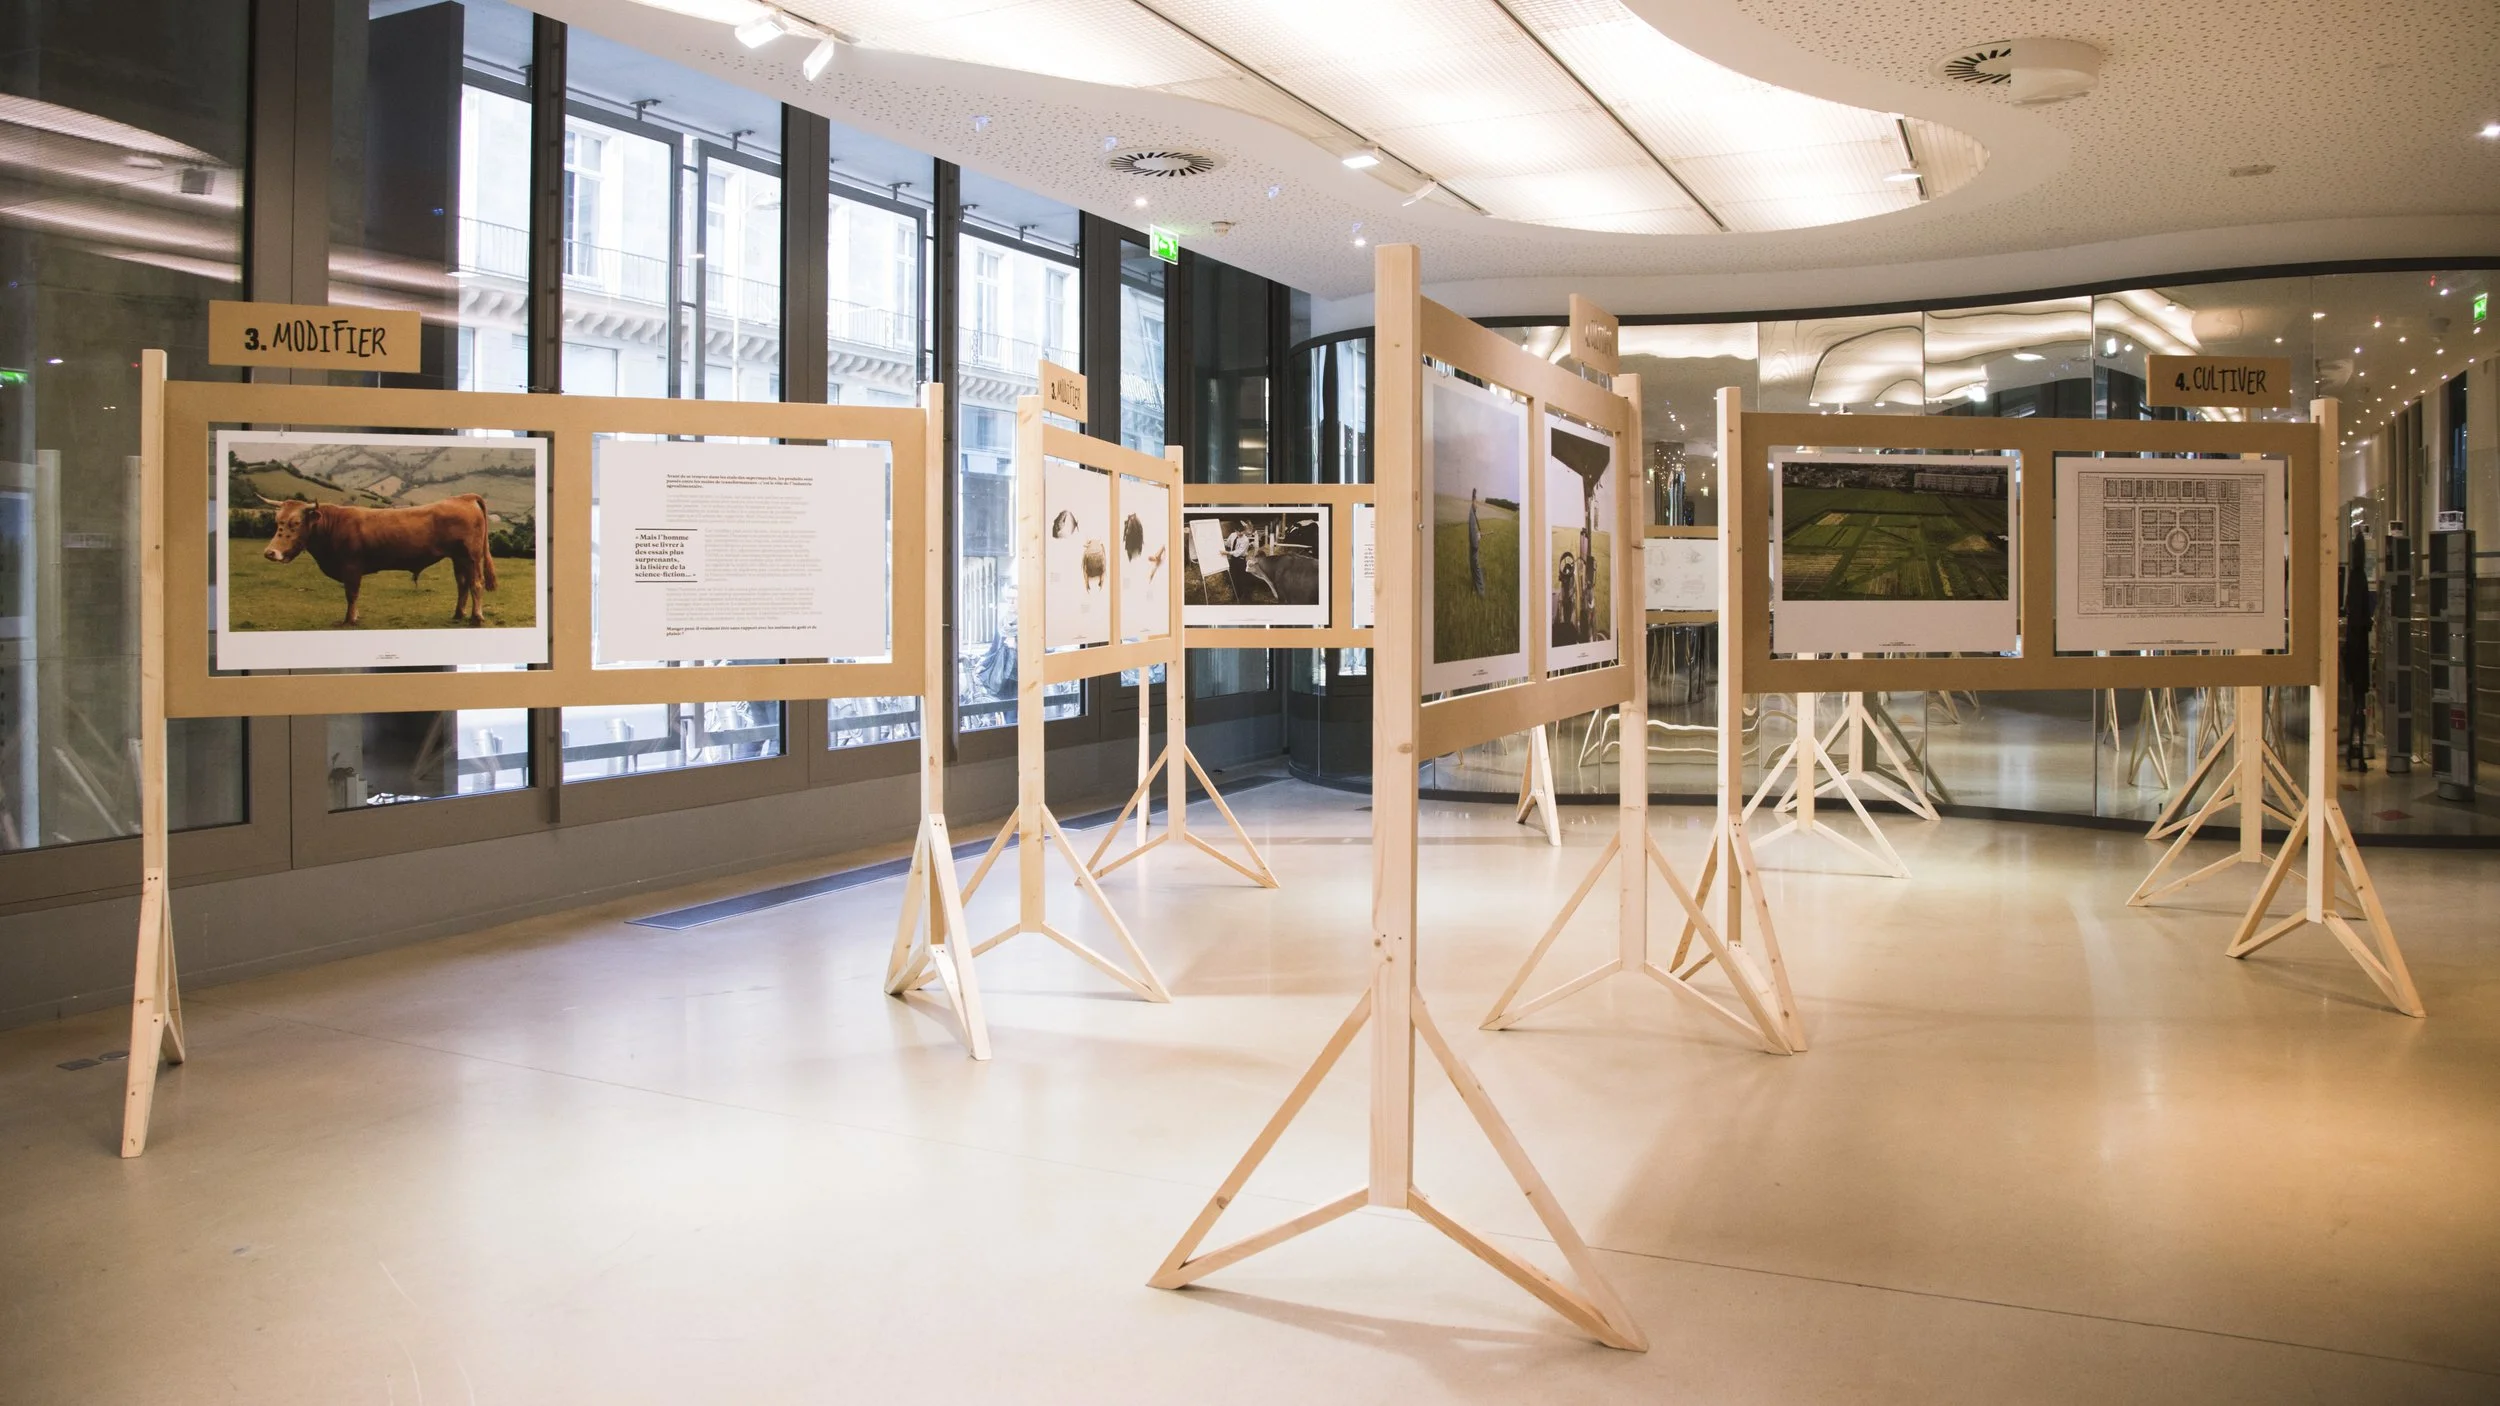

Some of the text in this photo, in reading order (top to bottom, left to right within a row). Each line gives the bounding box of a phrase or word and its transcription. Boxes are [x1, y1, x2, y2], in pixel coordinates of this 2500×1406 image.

[244, 319, 388, 358] 3. MODIFIER
[2174, 365, 2268, 395] 4. CULTIVER
[669, 549, 684, 557] plus
